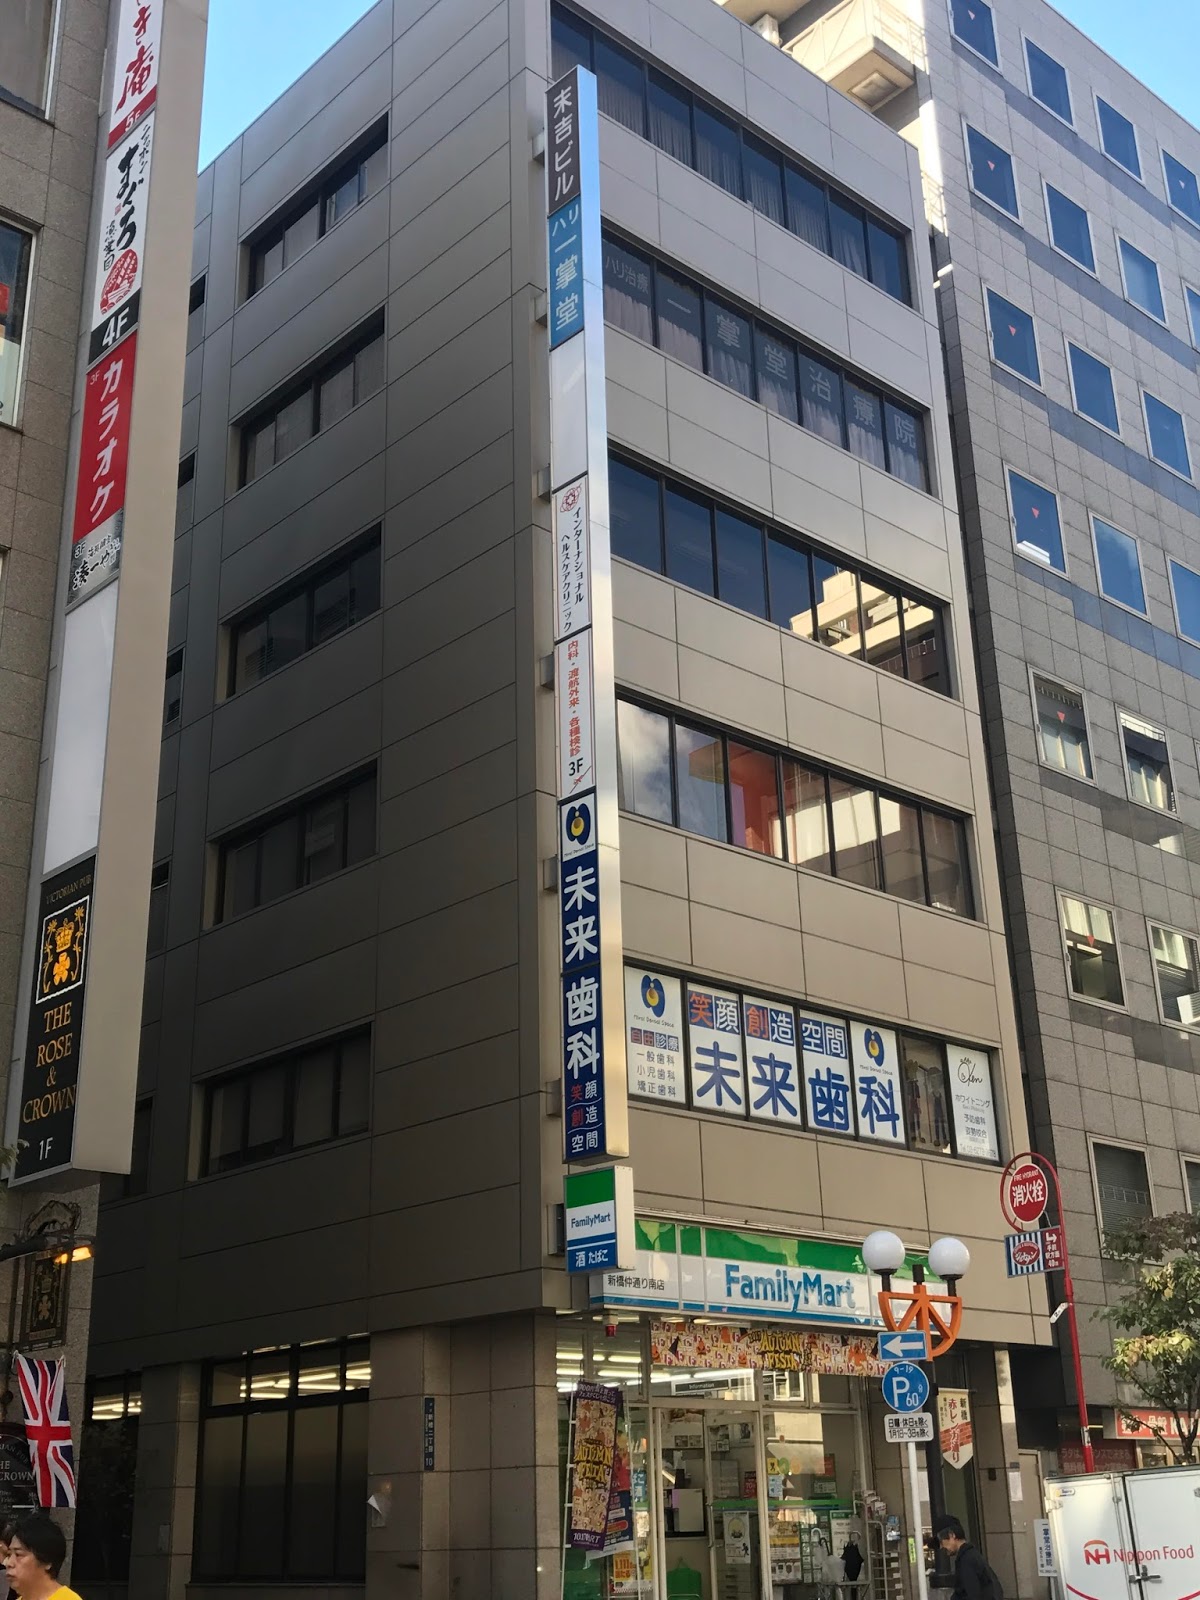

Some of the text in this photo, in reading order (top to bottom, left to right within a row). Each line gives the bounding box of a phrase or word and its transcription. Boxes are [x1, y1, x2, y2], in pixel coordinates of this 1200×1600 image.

[126, 109, 141, 131] 5F
[107, 143, 144, 251] まぐろ
[552, 203, 579, 237] ハリ
[554, 234, 578, 331] 一掌堂
[605, 255, 649, 295] ハリ治療
[102, 306, 130, 348] 4F
[90, 370, 101, 386] 3F
[667, 298, 916, 450] 一掌堂治療院
[90, 358, 125, 524] カラオケ
[572, 506, 584, 605] インターナショナル
[560, 535, 571, 632] ヘルスケアクリニック
[568, 758, 583, 778] 3F
[563, 865, 600, 1080] 未来歯科
[44, 1002, 72, 1033] THE
[36, 1033, 73, 1068] ROSE
[631, 1028, 679, 1052] 自由診療
[636, 1050, 675, 1066] 一般歯科
[46, 1066, 57, 1087] &
[636, 1064, 676, 1082] 小児歯科
[571, 1080, 598, 1101] 笑顔
[637, 1080, 676, 1097] 矯正歯科
[694, 1041, 900, 1138] 未来歯科
[22, 1083, 77, 1124] CROWN
[571, 1105, 598, 1128] 創造
[39, 1137, 53, 1162] 1F
[571, 1130, 598, 1153] 空間
[1014, 1169, 1039, 1182] FIRE HYDRANT
[1012, 1179, 1045, 1208] 消火栓
[571, 1212, 611, 1229] FamilyMart
[575, 1248, 609, 1267] 酒 たばこ
[607, 1274, 665, 1291] 新橋仲通り南店
[725, 1264, 855, 1312] FamilyMart
[760, 1330, 801, 1351] AUTUMN
[893, 1365, 914, 1375] 9-19
[892, 1376, 910, 1408] P
[906, 1393, 919, 1407] 60
[1113, 1544, 1194, 1565] Nippon Food
